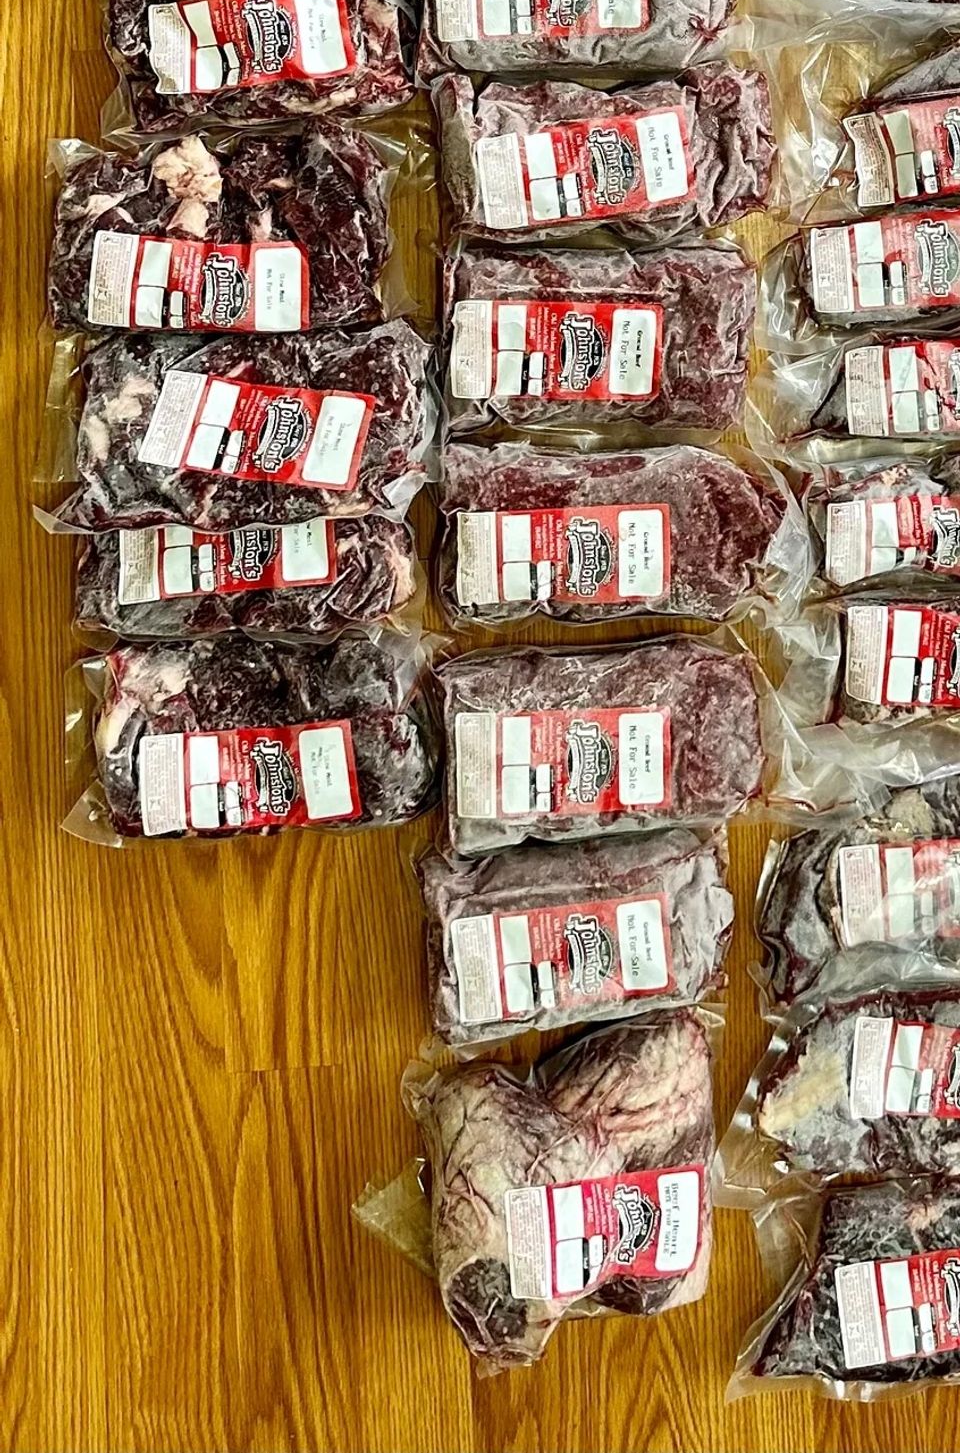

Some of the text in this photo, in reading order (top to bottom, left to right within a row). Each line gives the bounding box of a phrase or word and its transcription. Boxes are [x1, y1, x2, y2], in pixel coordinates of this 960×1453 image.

[258, 3, 283, 71] Johnston's
[596, 133, 625, 204] Johnston's
[211, 260, 232, 326] Johnston's
[925, 224, 948, 296] Johnston's
[571, 318, 591, 389] Johnston's
[621, 321, 629, 335] Not
[262, 399, 295, 471] Johnston's
[242, 530, 258, 577] nston's
[580, 521, 601, 595] Johnston's
[627, 522, 635, 537] Not
[628, 564, 636, 583] Sale
[262, 745, 285, 813] Johnston's
[577, 726, 599, 801] Johnston's
[628, 767, 636, 789] Sale
[573, 919, 603, 994] Johnston's
[627, 914, 640, 976] Not For Sale
